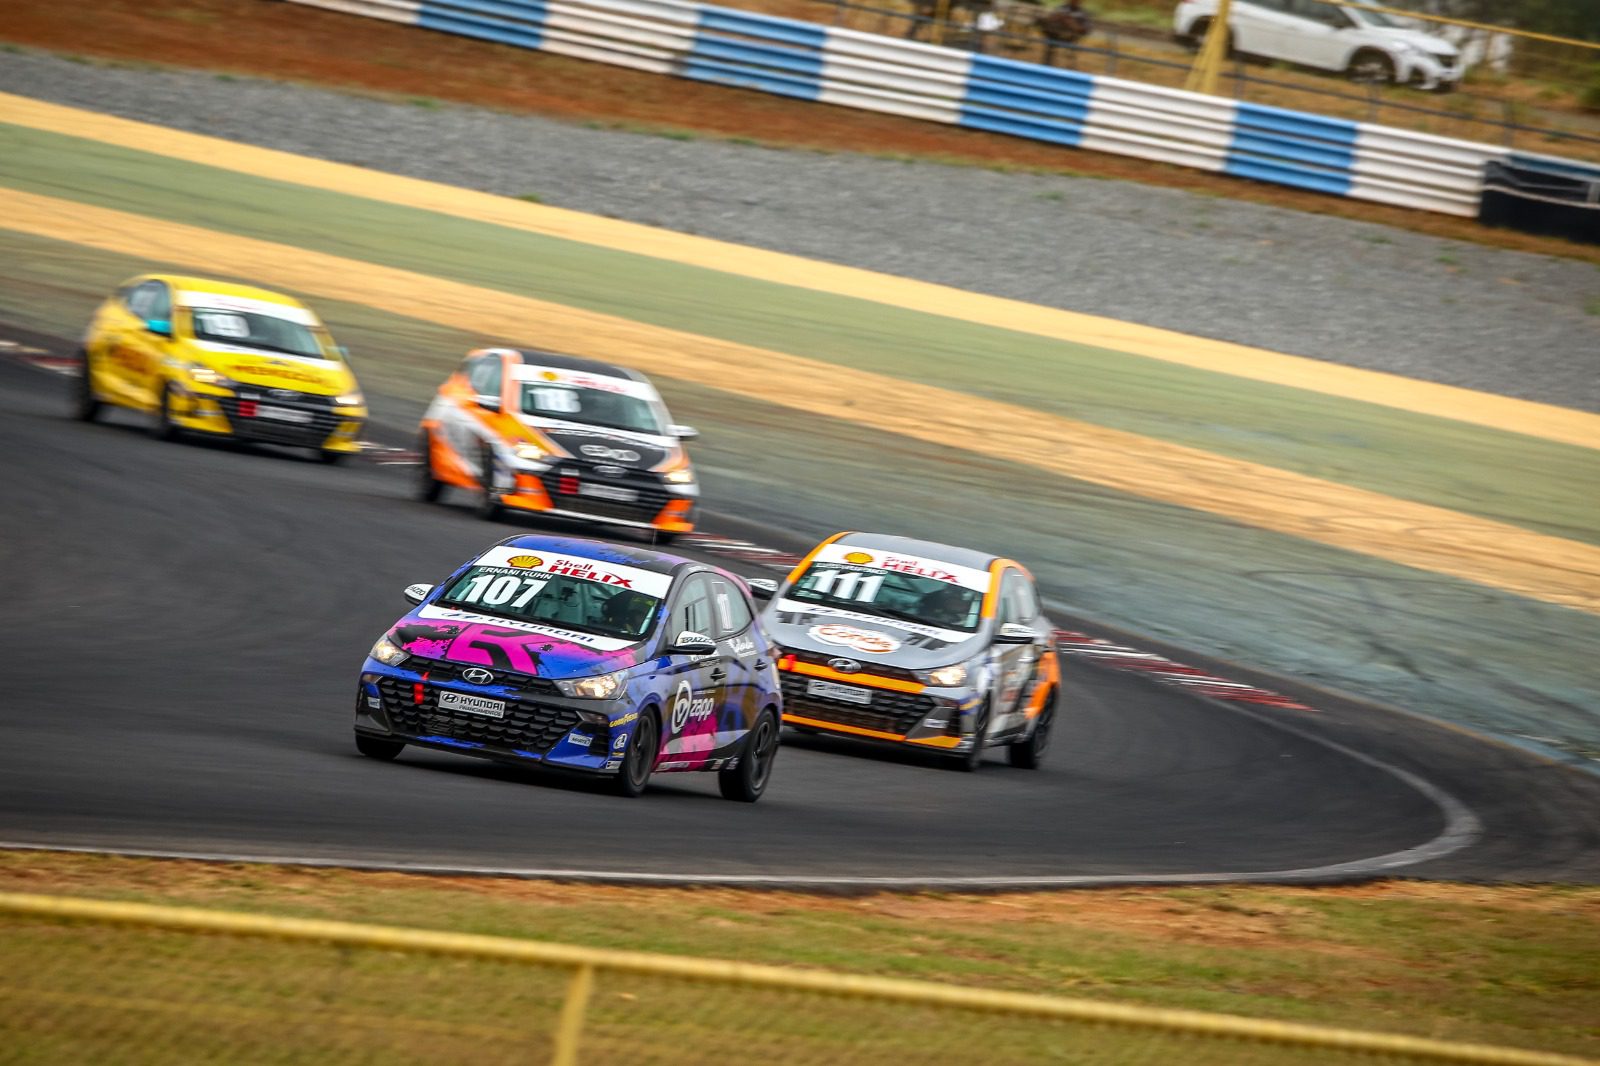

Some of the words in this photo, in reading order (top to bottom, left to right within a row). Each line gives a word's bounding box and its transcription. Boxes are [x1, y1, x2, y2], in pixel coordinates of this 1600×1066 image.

[478, 566, 520, 576] ERNANI
[520, 569, 554, 580] KUHN
[547, 565, 633, 588] HELIX
[554, 559, 594, 571] Shell
[881, 562, 960, 584] HELIX
[464, 574, 549, 608] 107
[811, 569, 887, 603] 111
[488, 617, 596, 643] HYUNDAI
[460, 696, 504, 711] HYUNDAI
[689, 697, 715, 721] zapp
